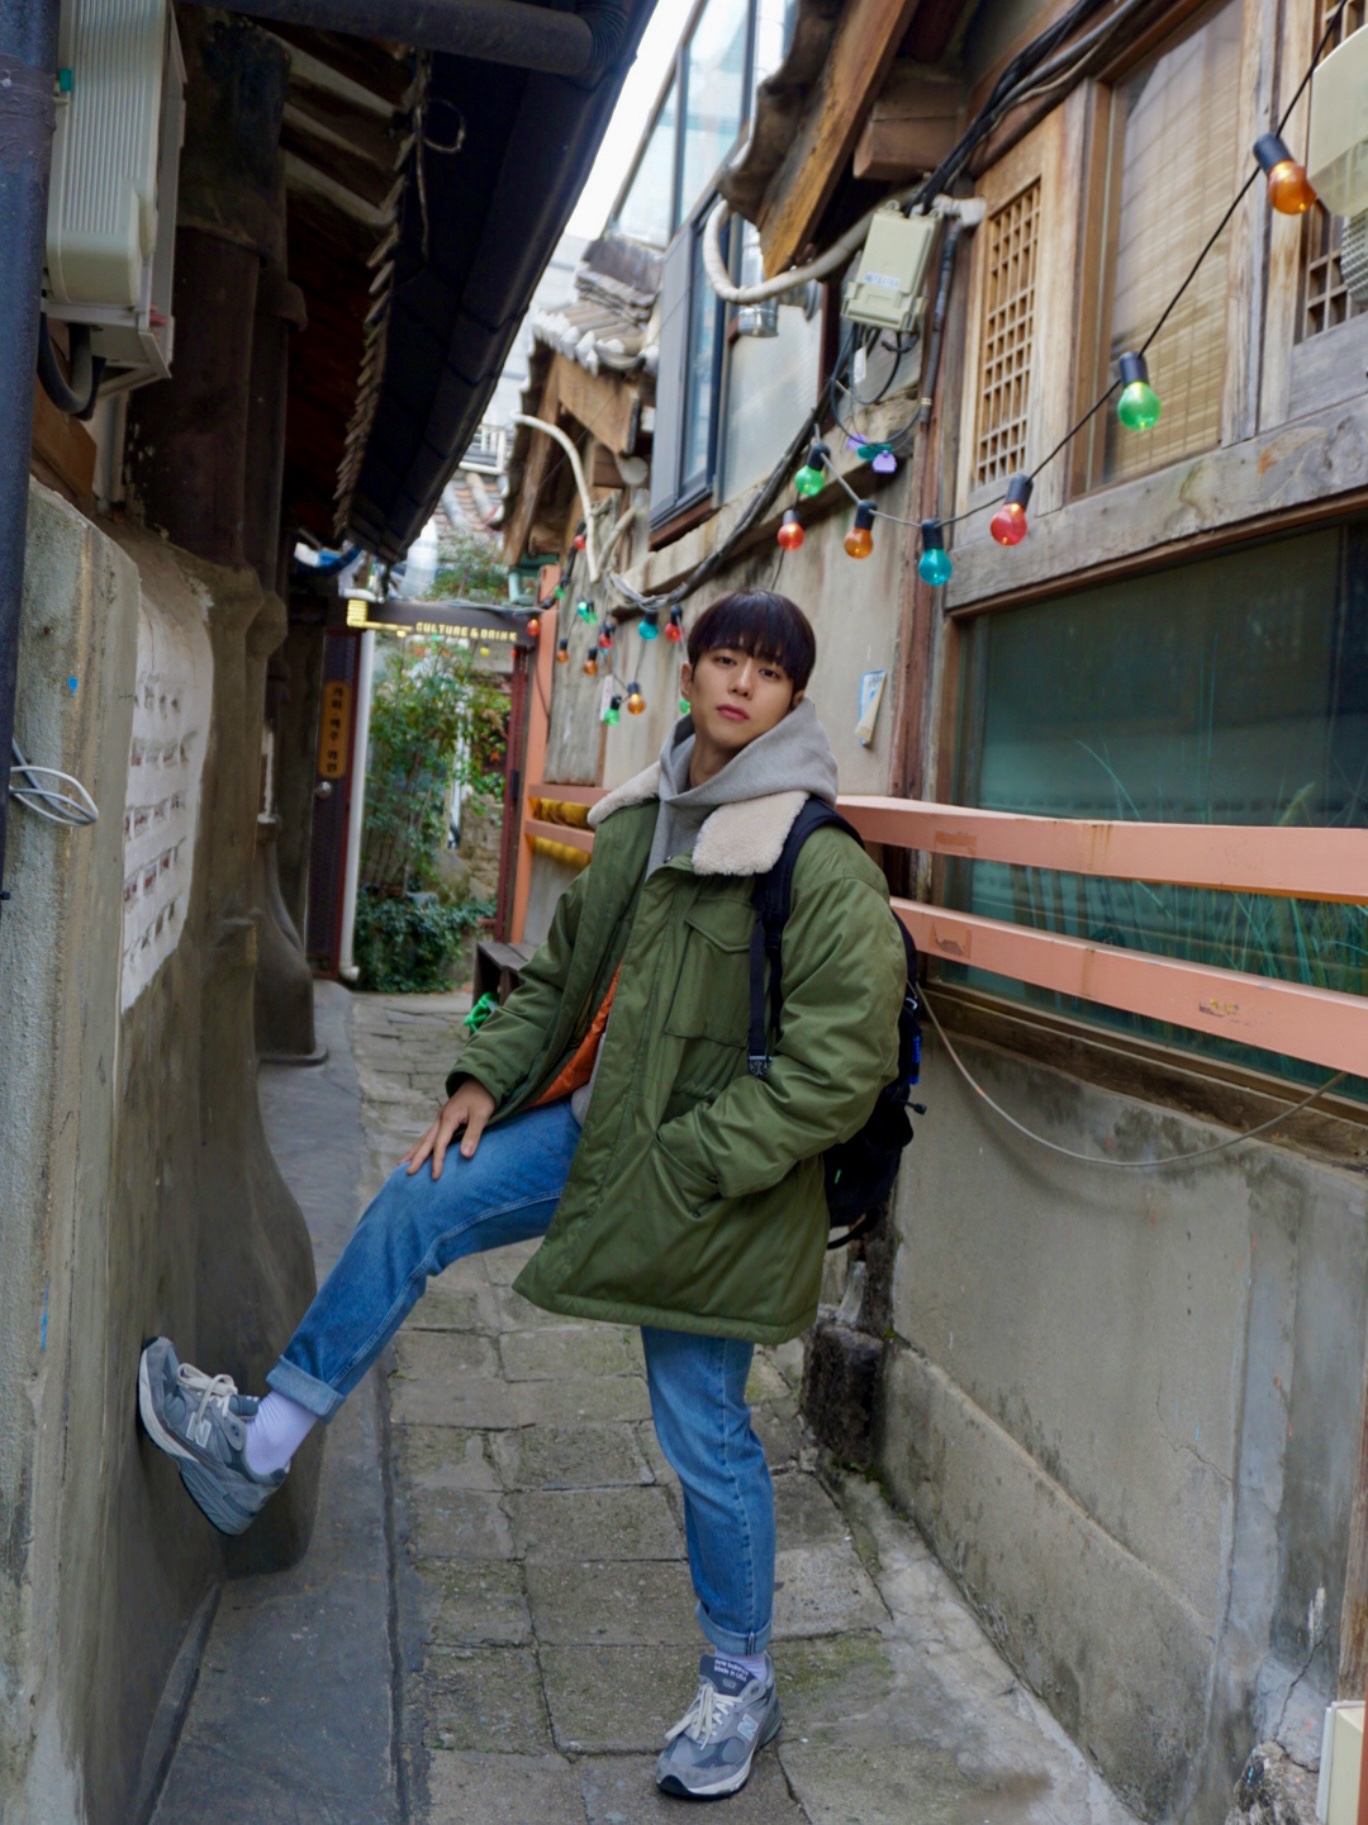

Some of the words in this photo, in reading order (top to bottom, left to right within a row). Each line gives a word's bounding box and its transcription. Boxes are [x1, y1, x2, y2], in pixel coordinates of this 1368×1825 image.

[416, 621, 468, 636] CULTURE
[470, 627, 479, 639] &
[480, 629, 517, 642] DRINK
